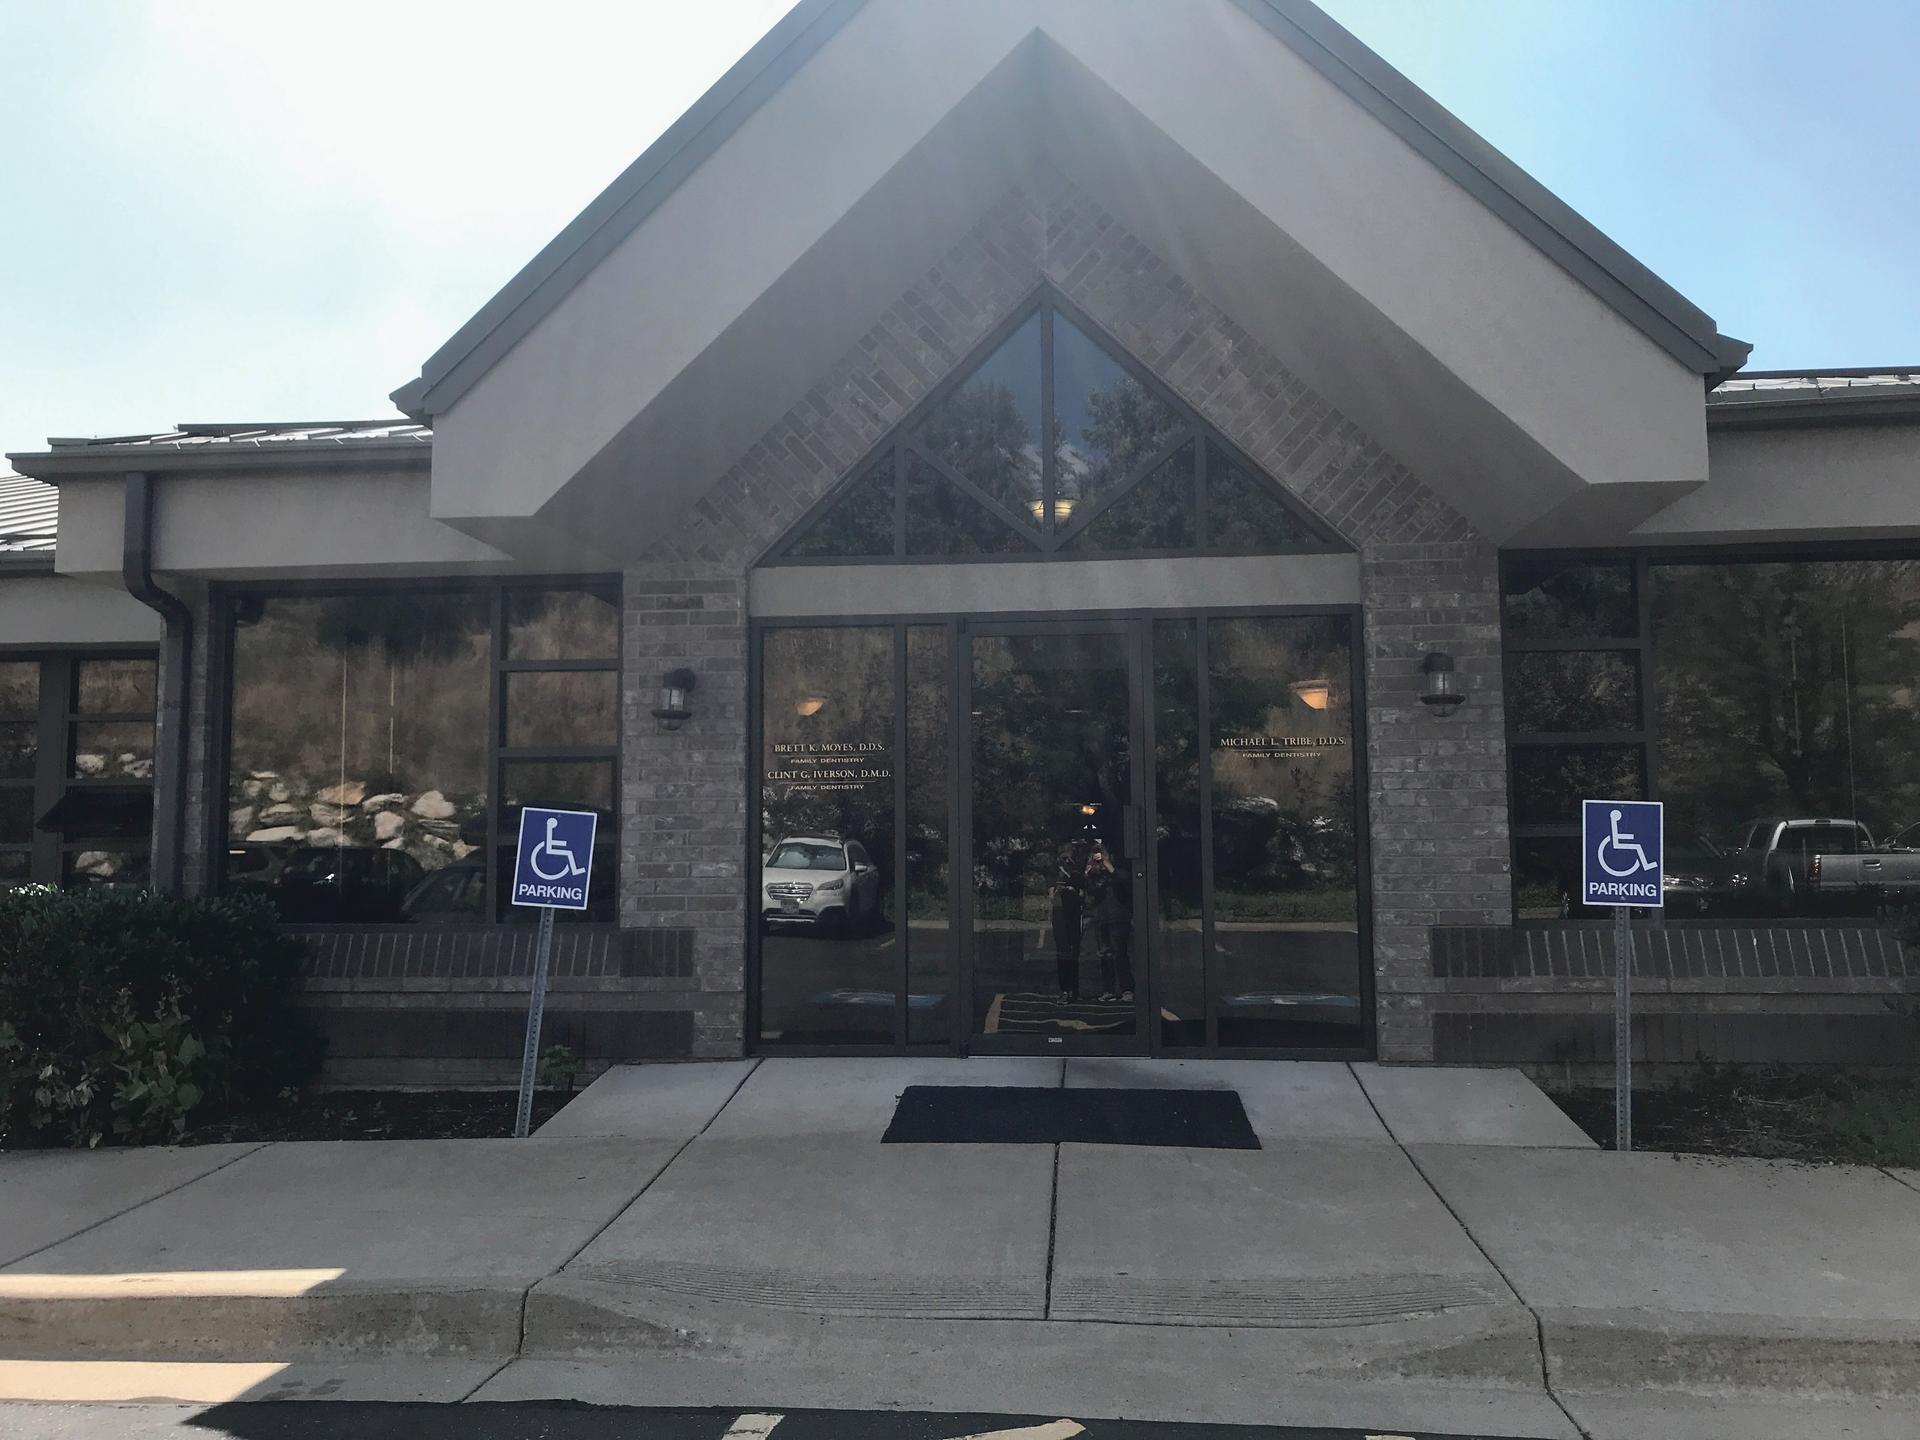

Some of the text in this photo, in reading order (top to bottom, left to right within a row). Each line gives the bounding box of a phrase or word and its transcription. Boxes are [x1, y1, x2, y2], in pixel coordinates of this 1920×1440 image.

[1220, 737, 1347, 746] MICHAEL L. TRIBE, D.D.S.
[774, 742, 885, 752] BRETT K. MOYES, D.D.S.
[767, 769, 892, 779] CLINT G. IVERSON, D.M.D.
[518, 883, 583, 900] PARKING
[1589, 882, 1657, 897] PARKING
